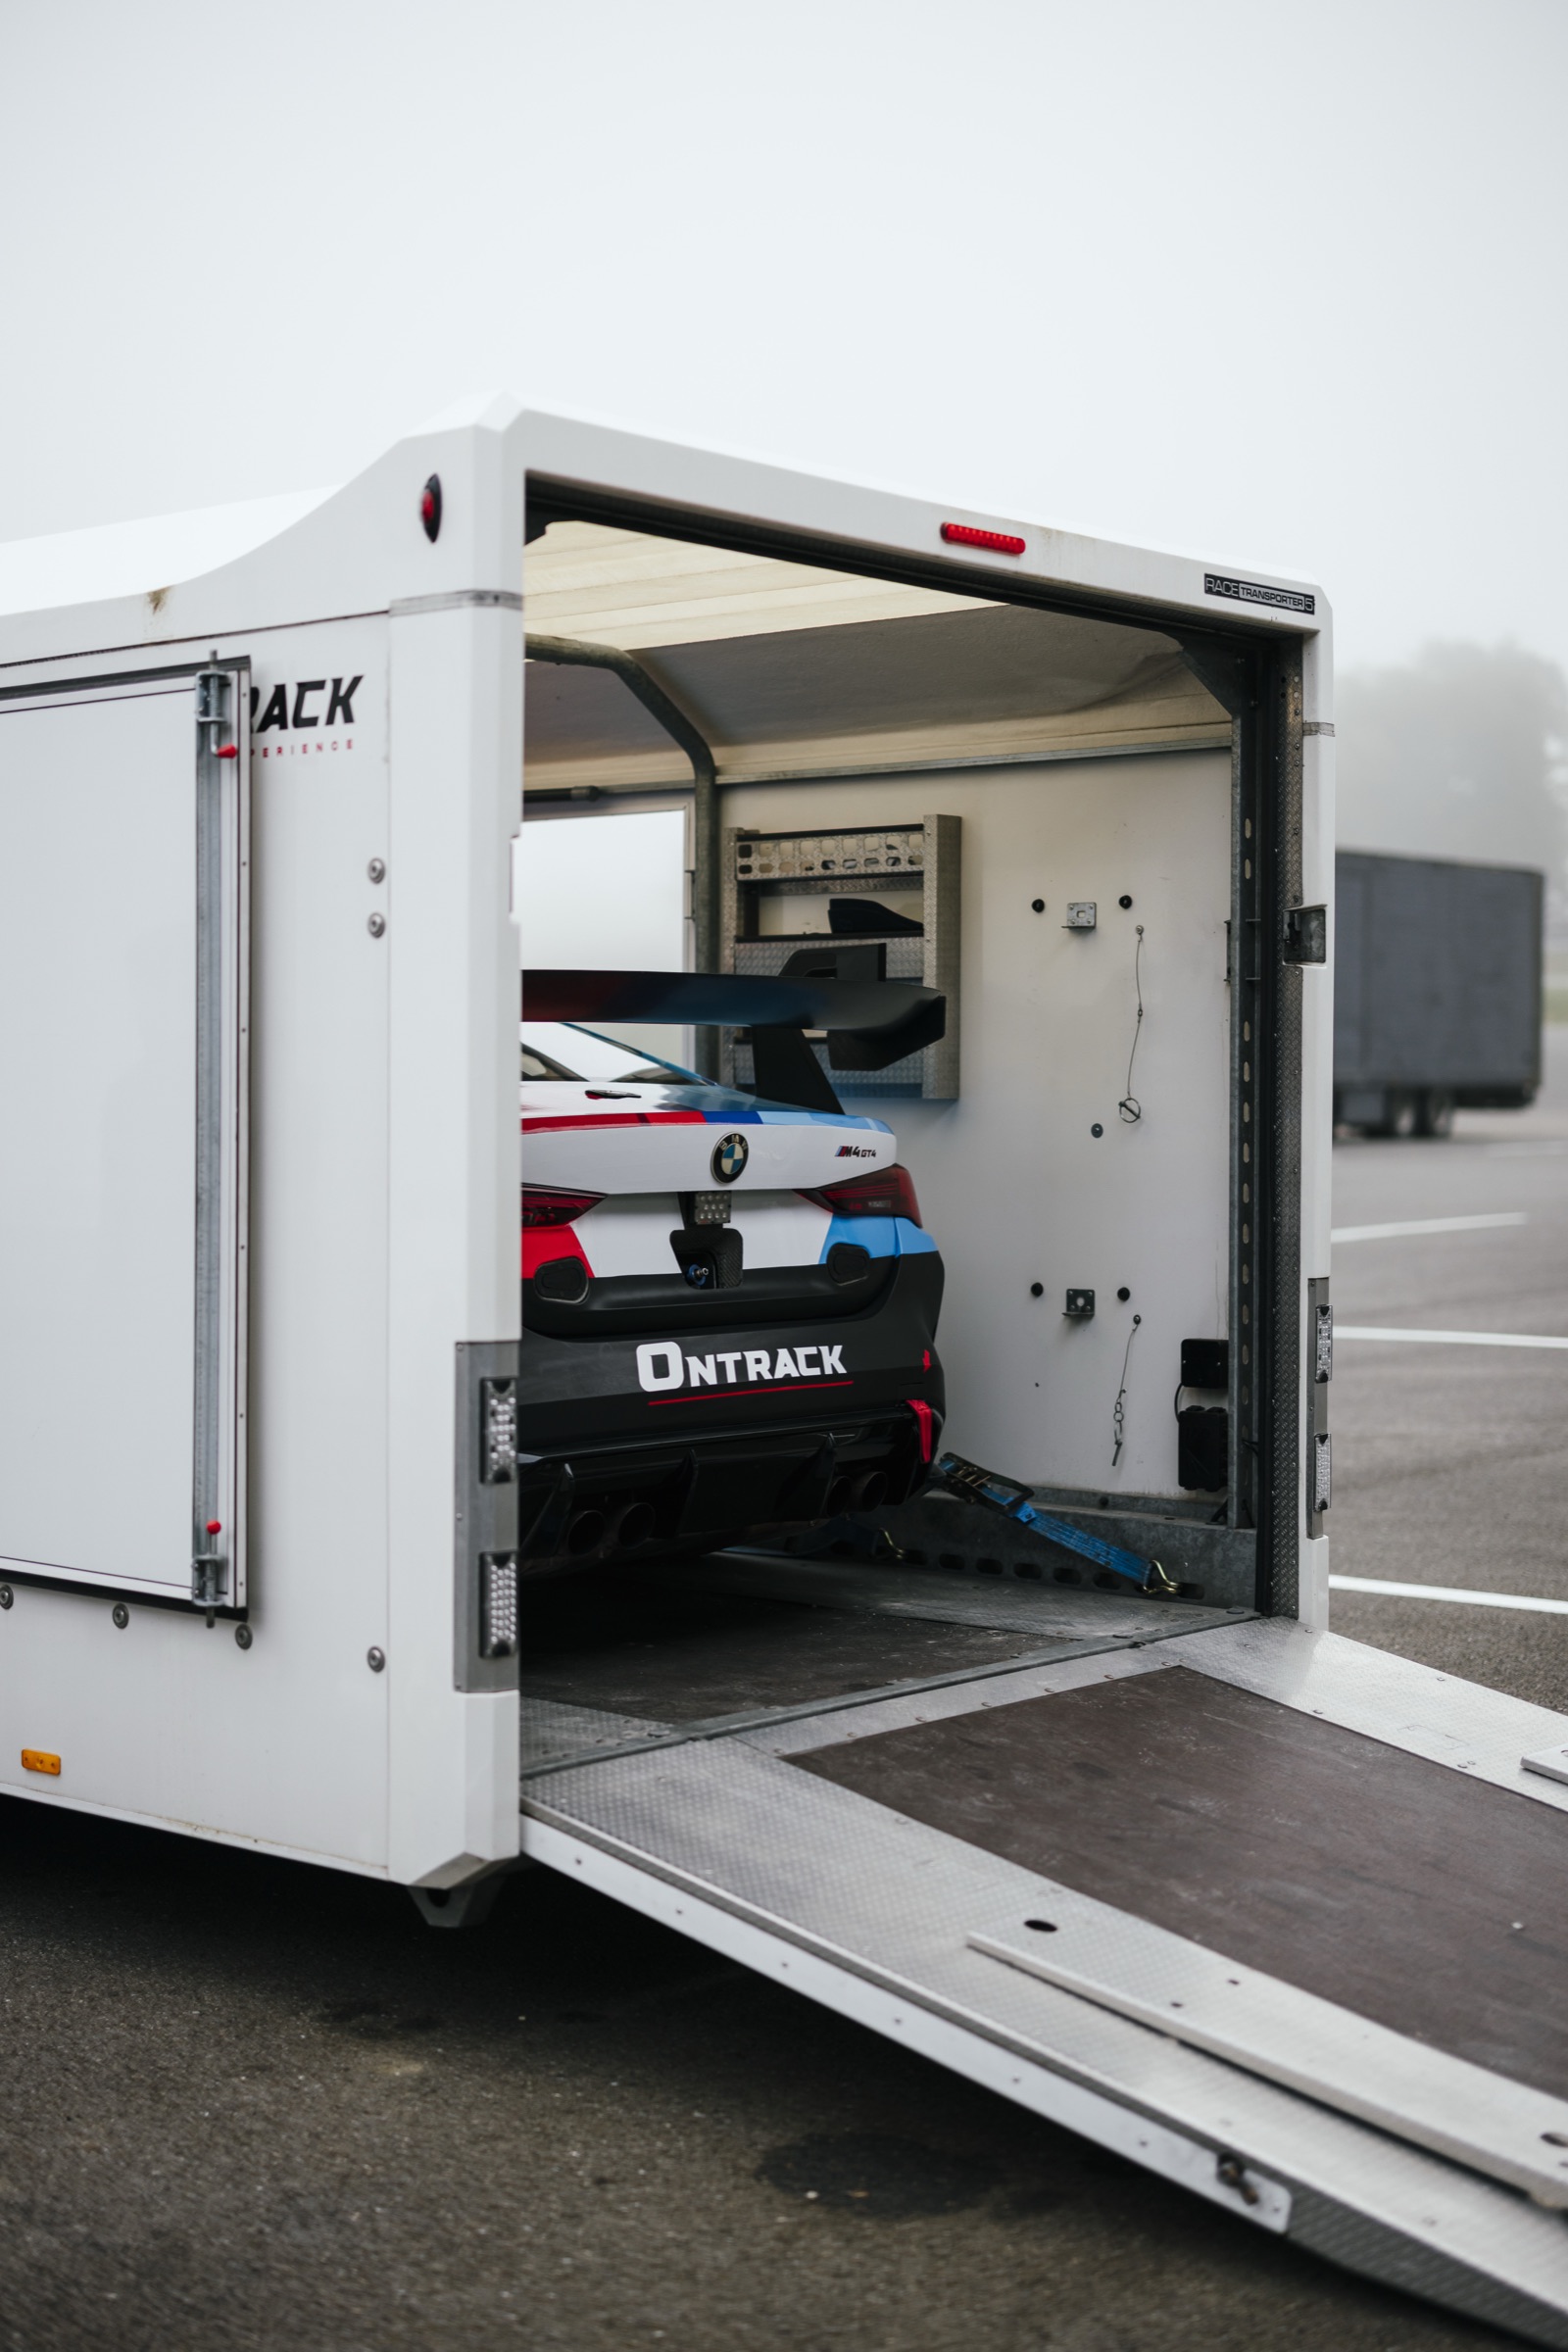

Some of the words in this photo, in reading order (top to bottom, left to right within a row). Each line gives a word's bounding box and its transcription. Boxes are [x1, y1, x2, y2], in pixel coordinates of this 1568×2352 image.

[1204, 577, 1239, 597] RACE
[1240, 586, 1303, 608] TRANSPORTER
[636, 1341, 848, 1393] ONTRACK
